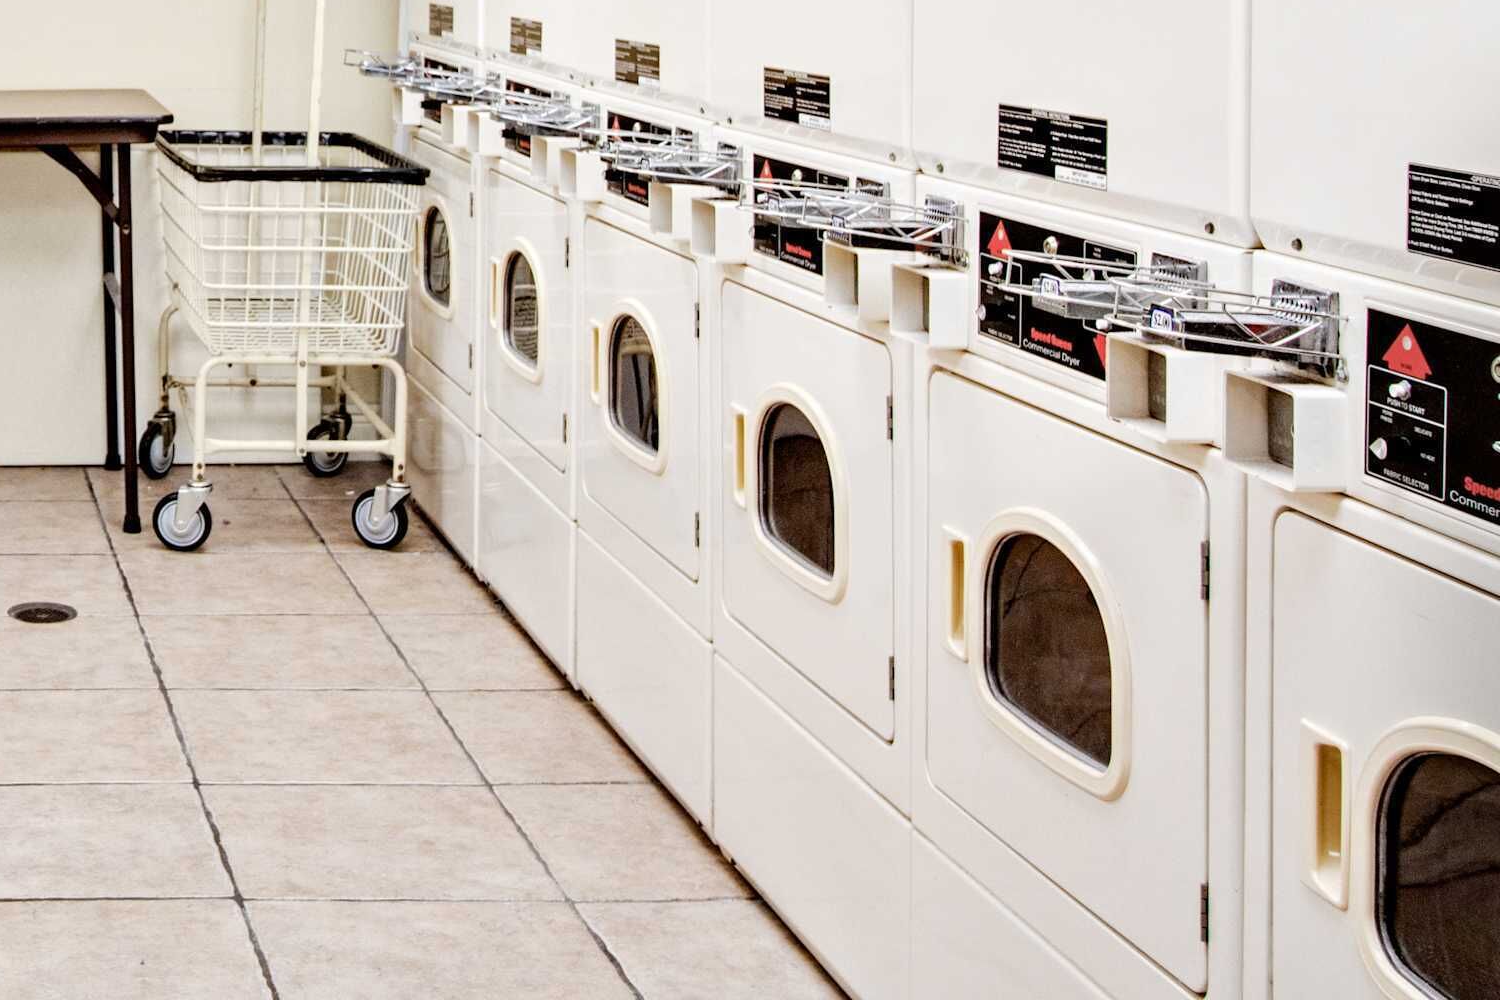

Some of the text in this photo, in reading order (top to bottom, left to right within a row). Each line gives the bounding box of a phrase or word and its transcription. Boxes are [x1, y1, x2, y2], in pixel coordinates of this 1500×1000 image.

[1022, 338, 1081, 367] Commercial Dryer
[1408, 403, 1426, 416] START
[1402, 474, 1430, 492] SELECTOR
